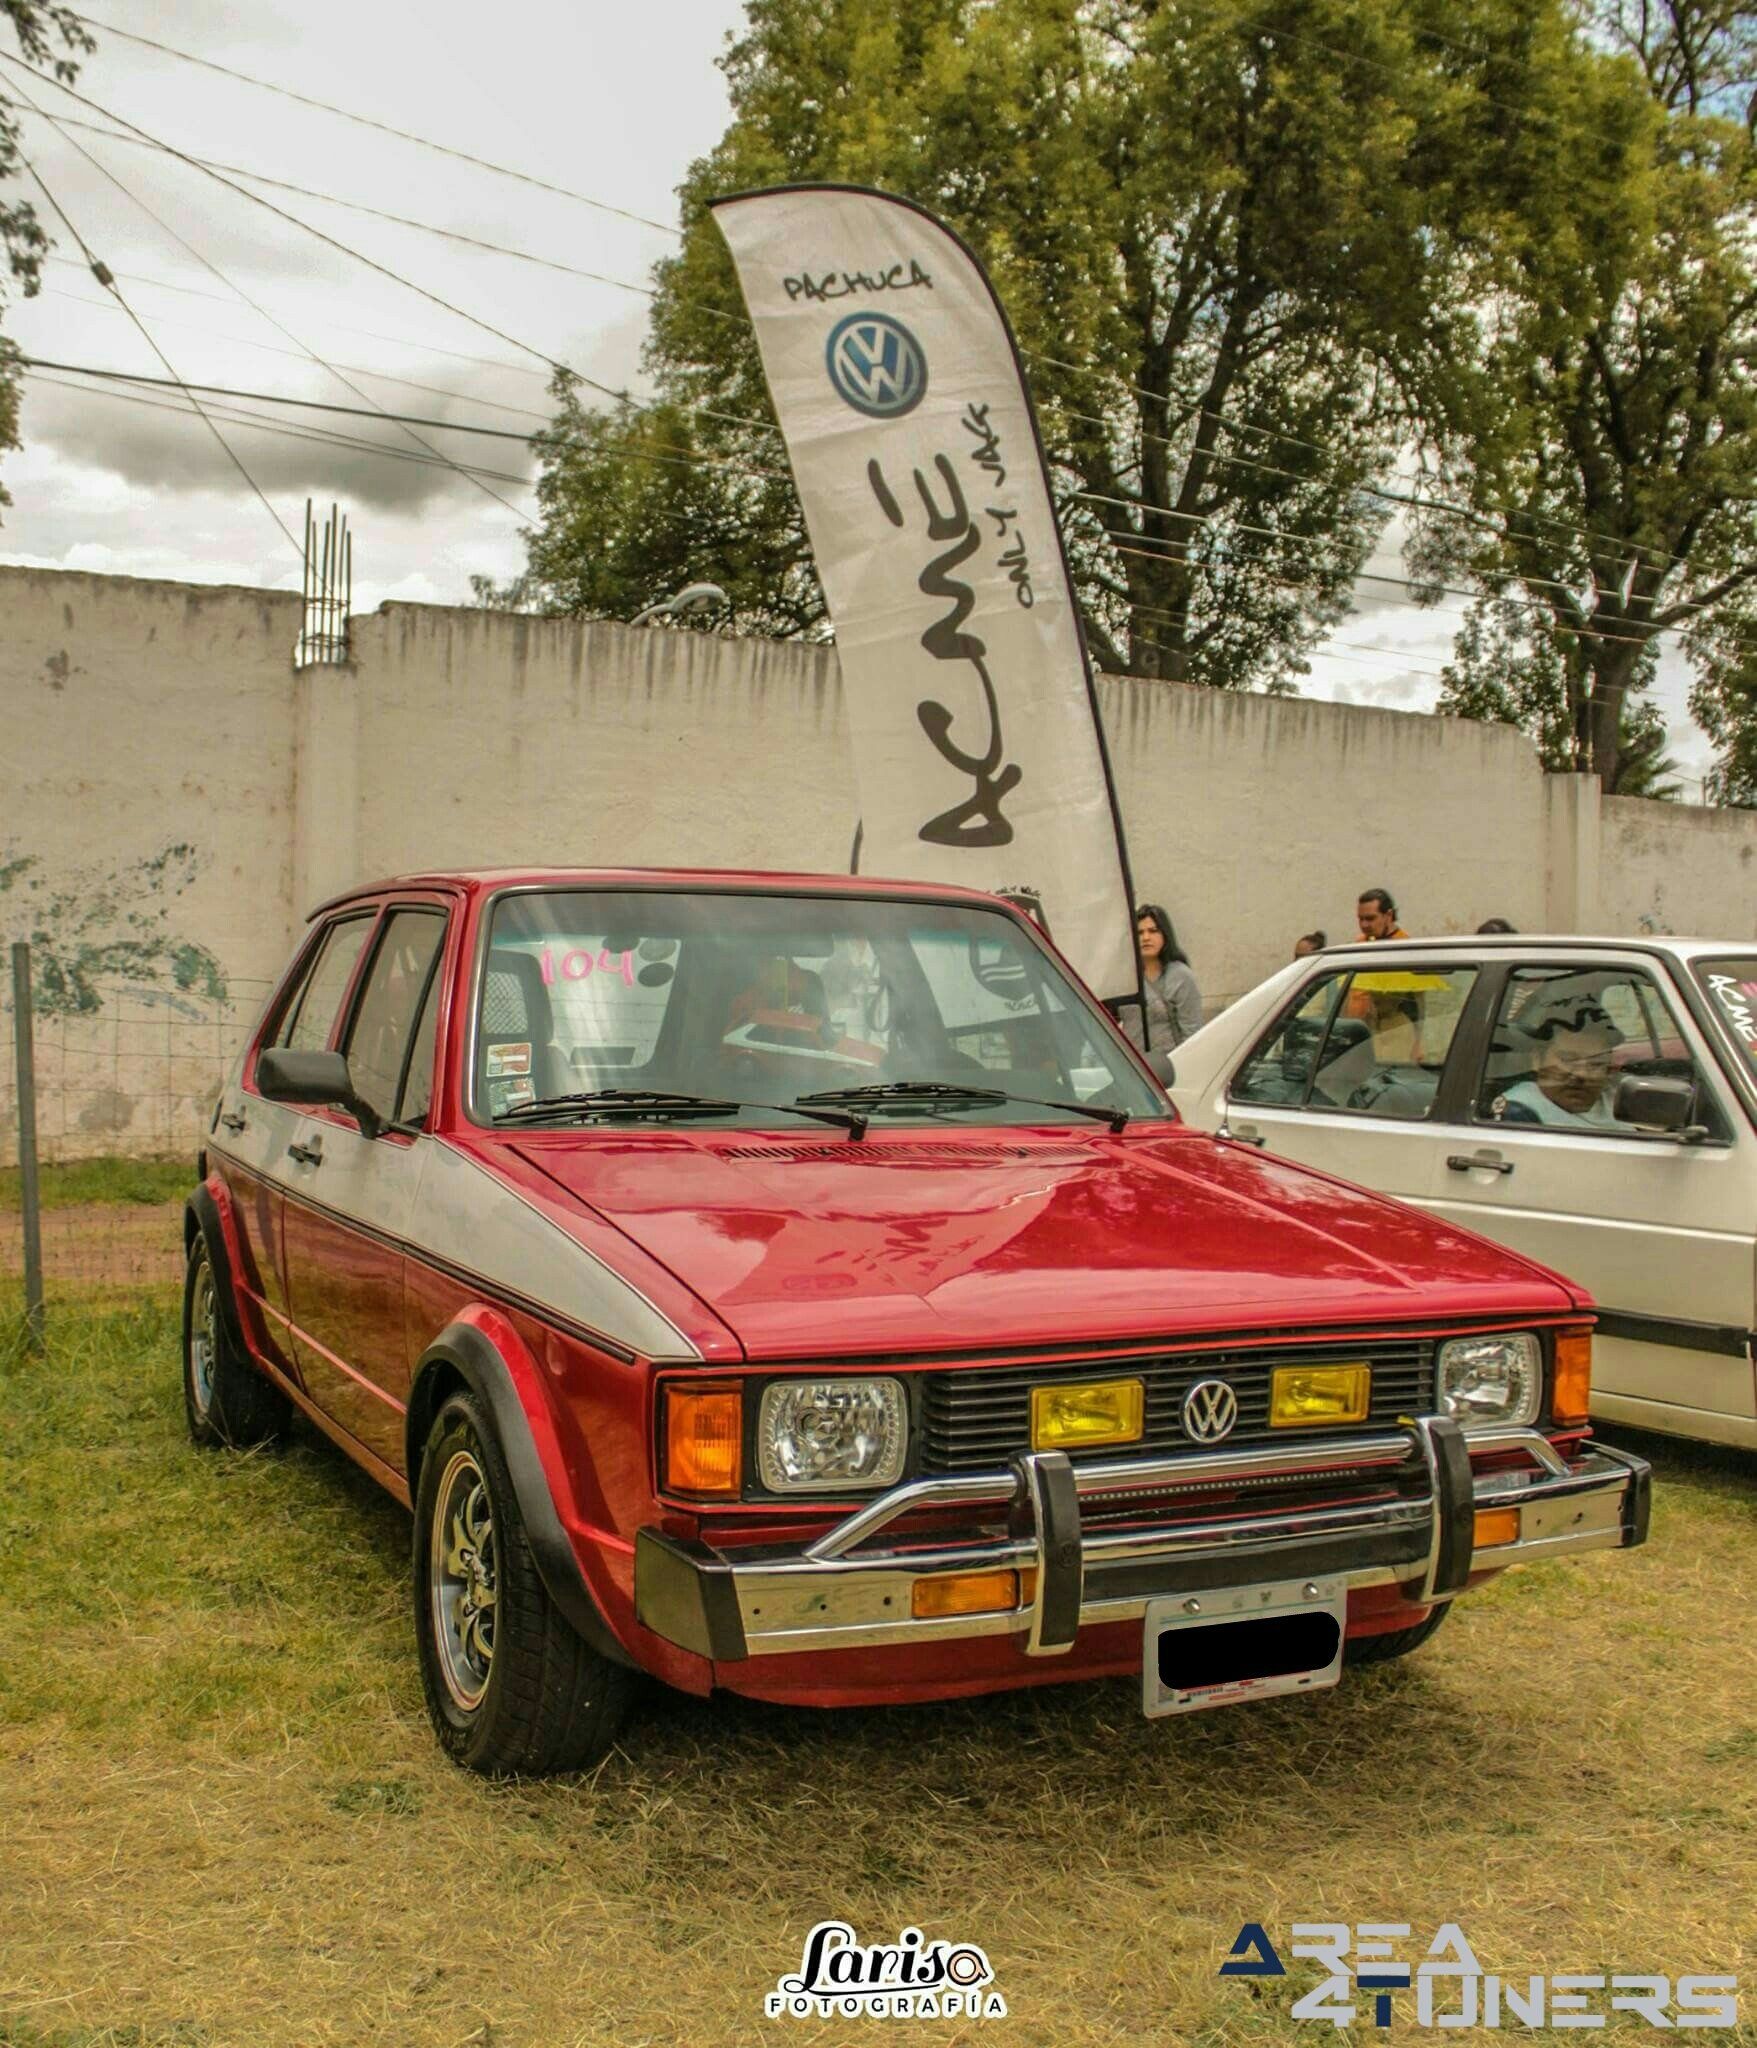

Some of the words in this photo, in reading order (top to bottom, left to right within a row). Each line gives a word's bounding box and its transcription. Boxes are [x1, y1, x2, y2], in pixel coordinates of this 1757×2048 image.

[783, 259, 934, 302] PACHUCA
[984, 507, 1034, 609] ONLY
[540, 946, 634, 988] 104
